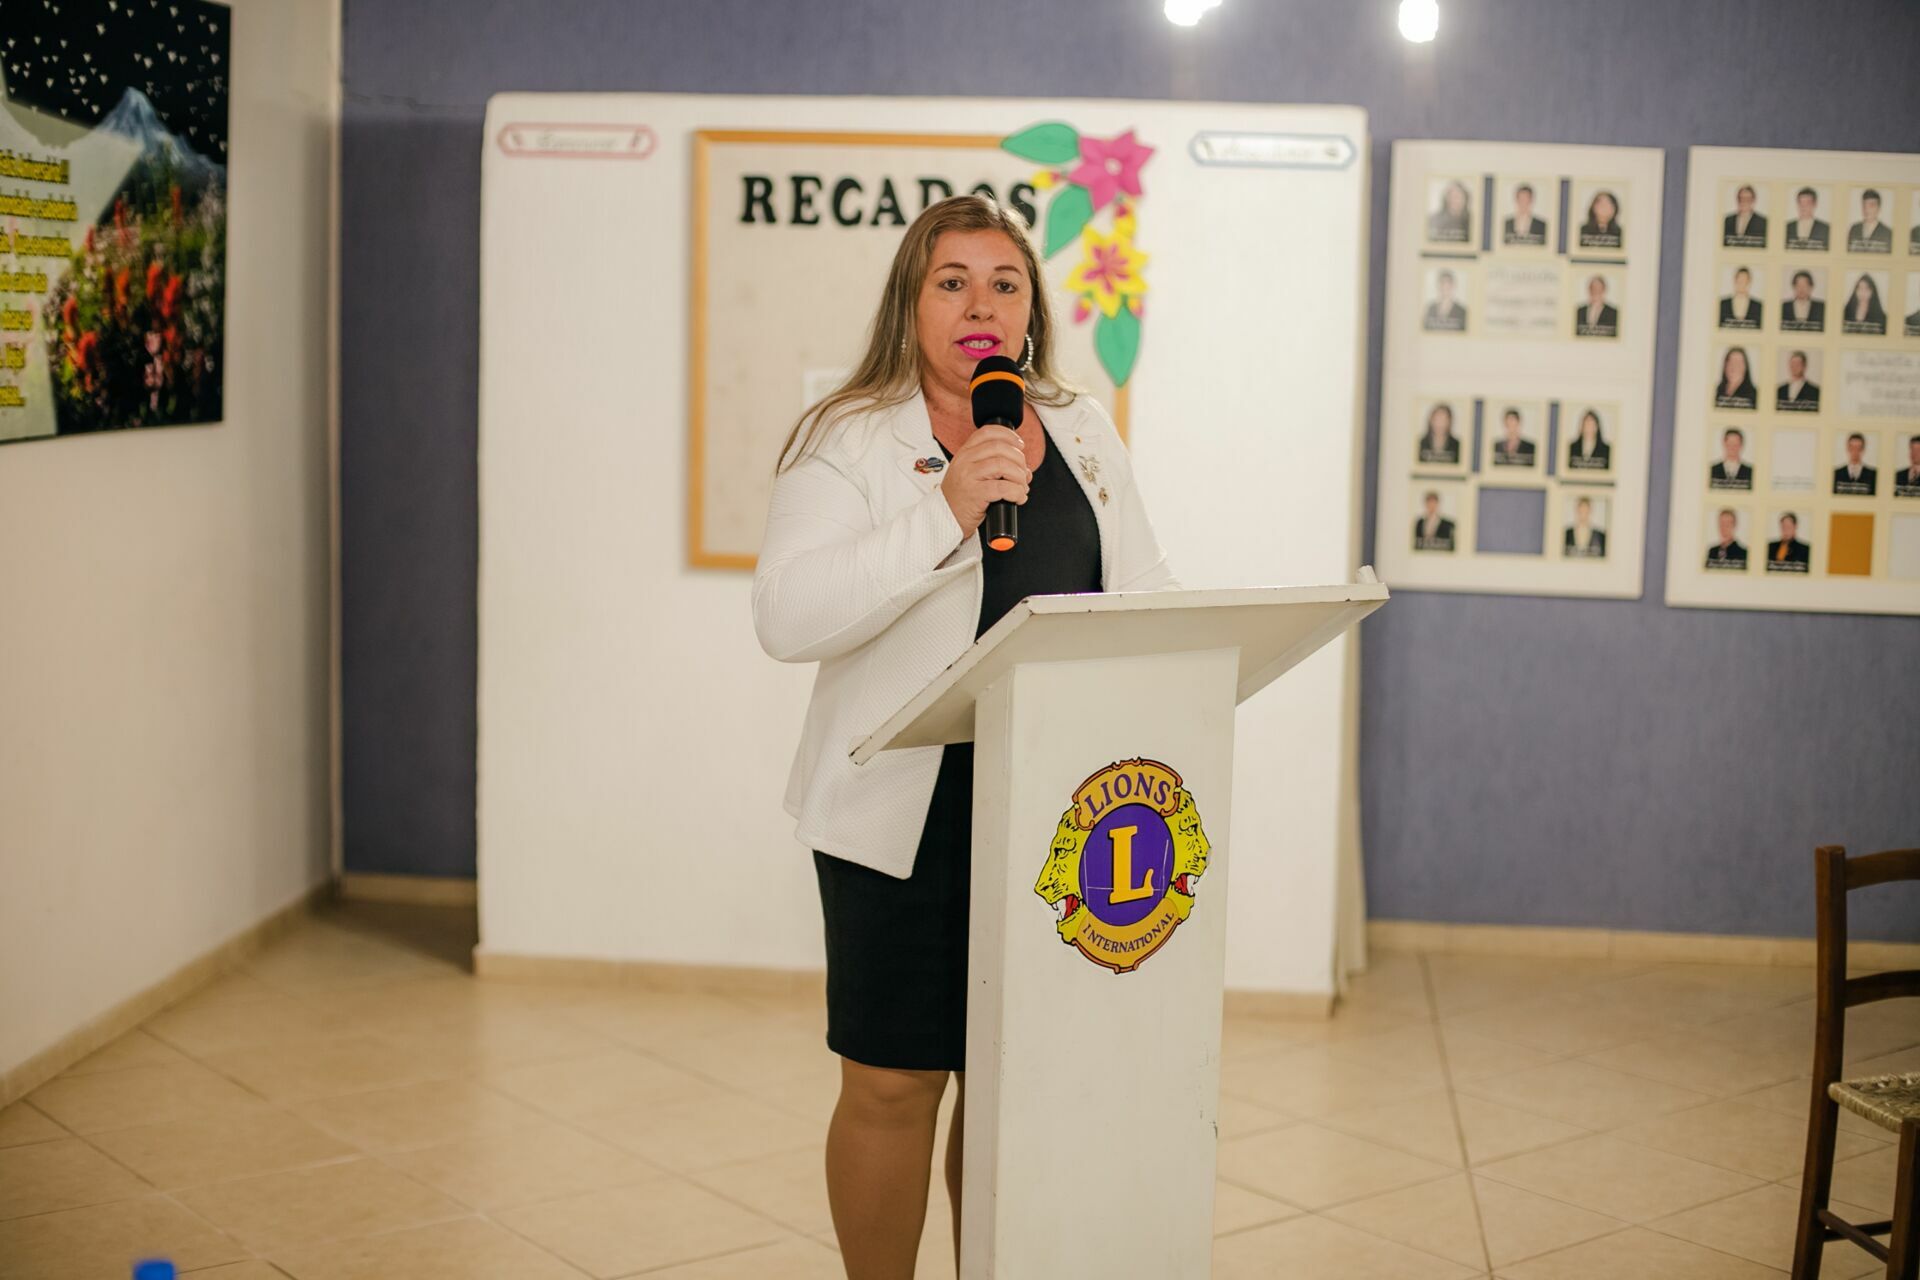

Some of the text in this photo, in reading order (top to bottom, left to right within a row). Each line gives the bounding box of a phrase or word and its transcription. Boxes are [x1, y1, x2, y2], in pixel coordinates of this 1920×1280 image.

[1084, 772, 1171, 818] LIONS
[1108, 825, 1154, 904] L
[1082, 911, 1175, 953] INTERNATIONAL
